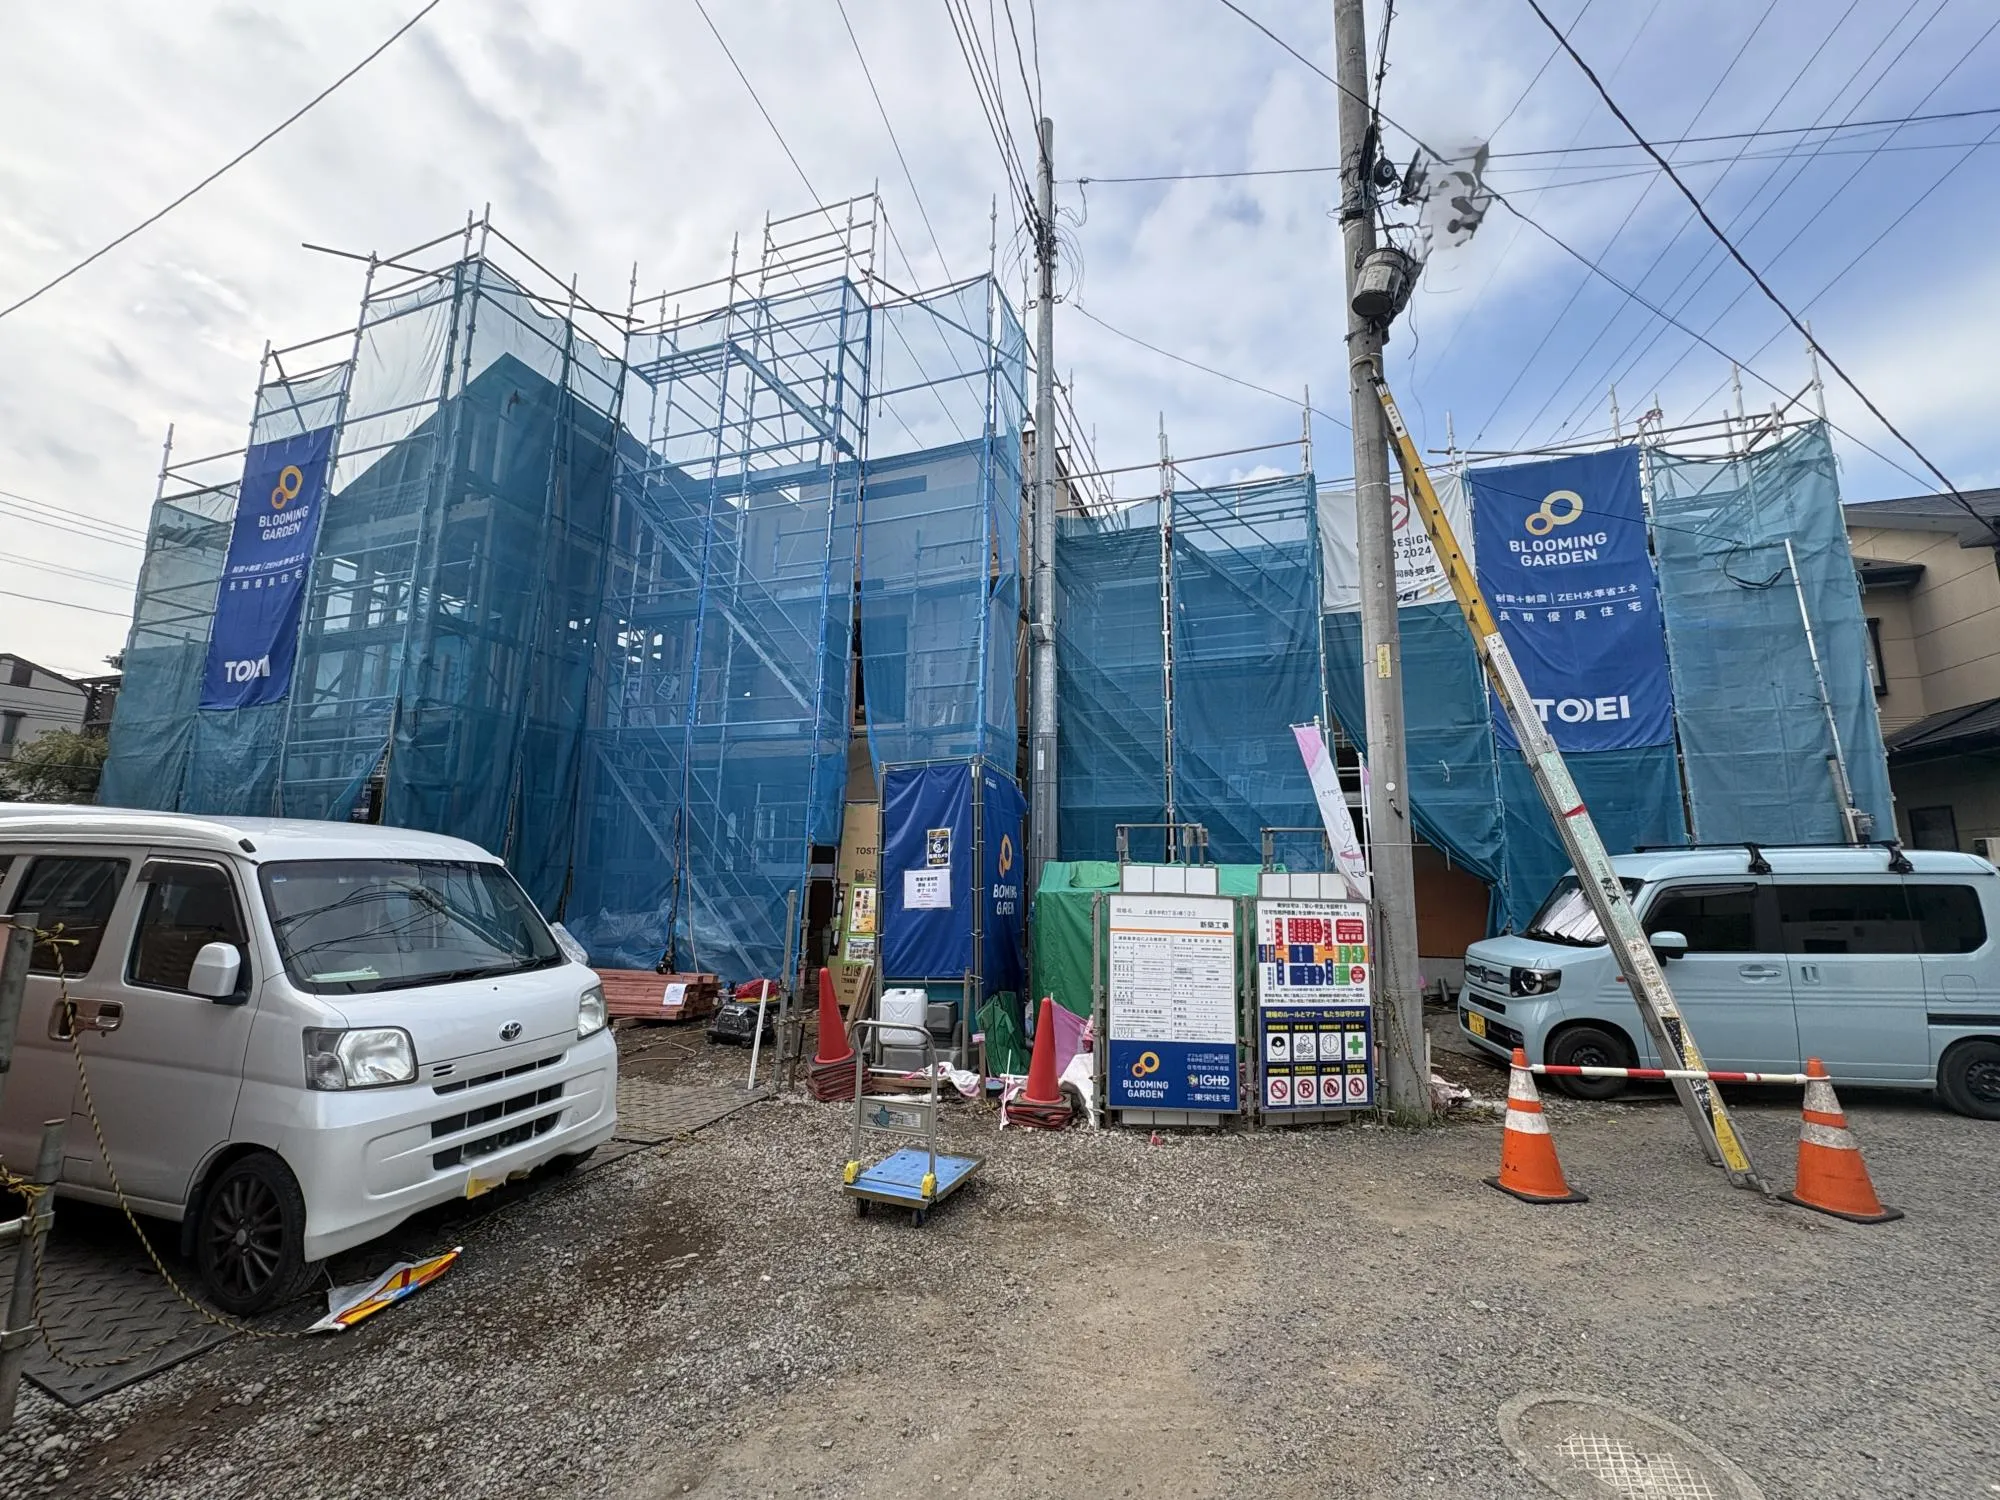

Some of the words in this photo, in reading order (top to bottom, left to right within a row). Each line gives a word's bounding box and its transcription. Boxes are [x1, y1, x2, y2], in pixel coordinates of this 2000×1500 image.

[258, 506, 309, 527] BLOOMING
[262, 522, 302, 540] GARDEN
[1509, 532, 1608, 552] BLOOMING
[1404, 546, 1431, 558] 2024
[1520, 549, 1598, 566] GARDEN
[1499, 602, 1643, 623] 長期優良住宅
[1200, 921, 1229, 929] 新築工事
[1122, 1080, 1168, 1090] BLOOMING
[1128, 1090, 1164, 1098] GARDEN
